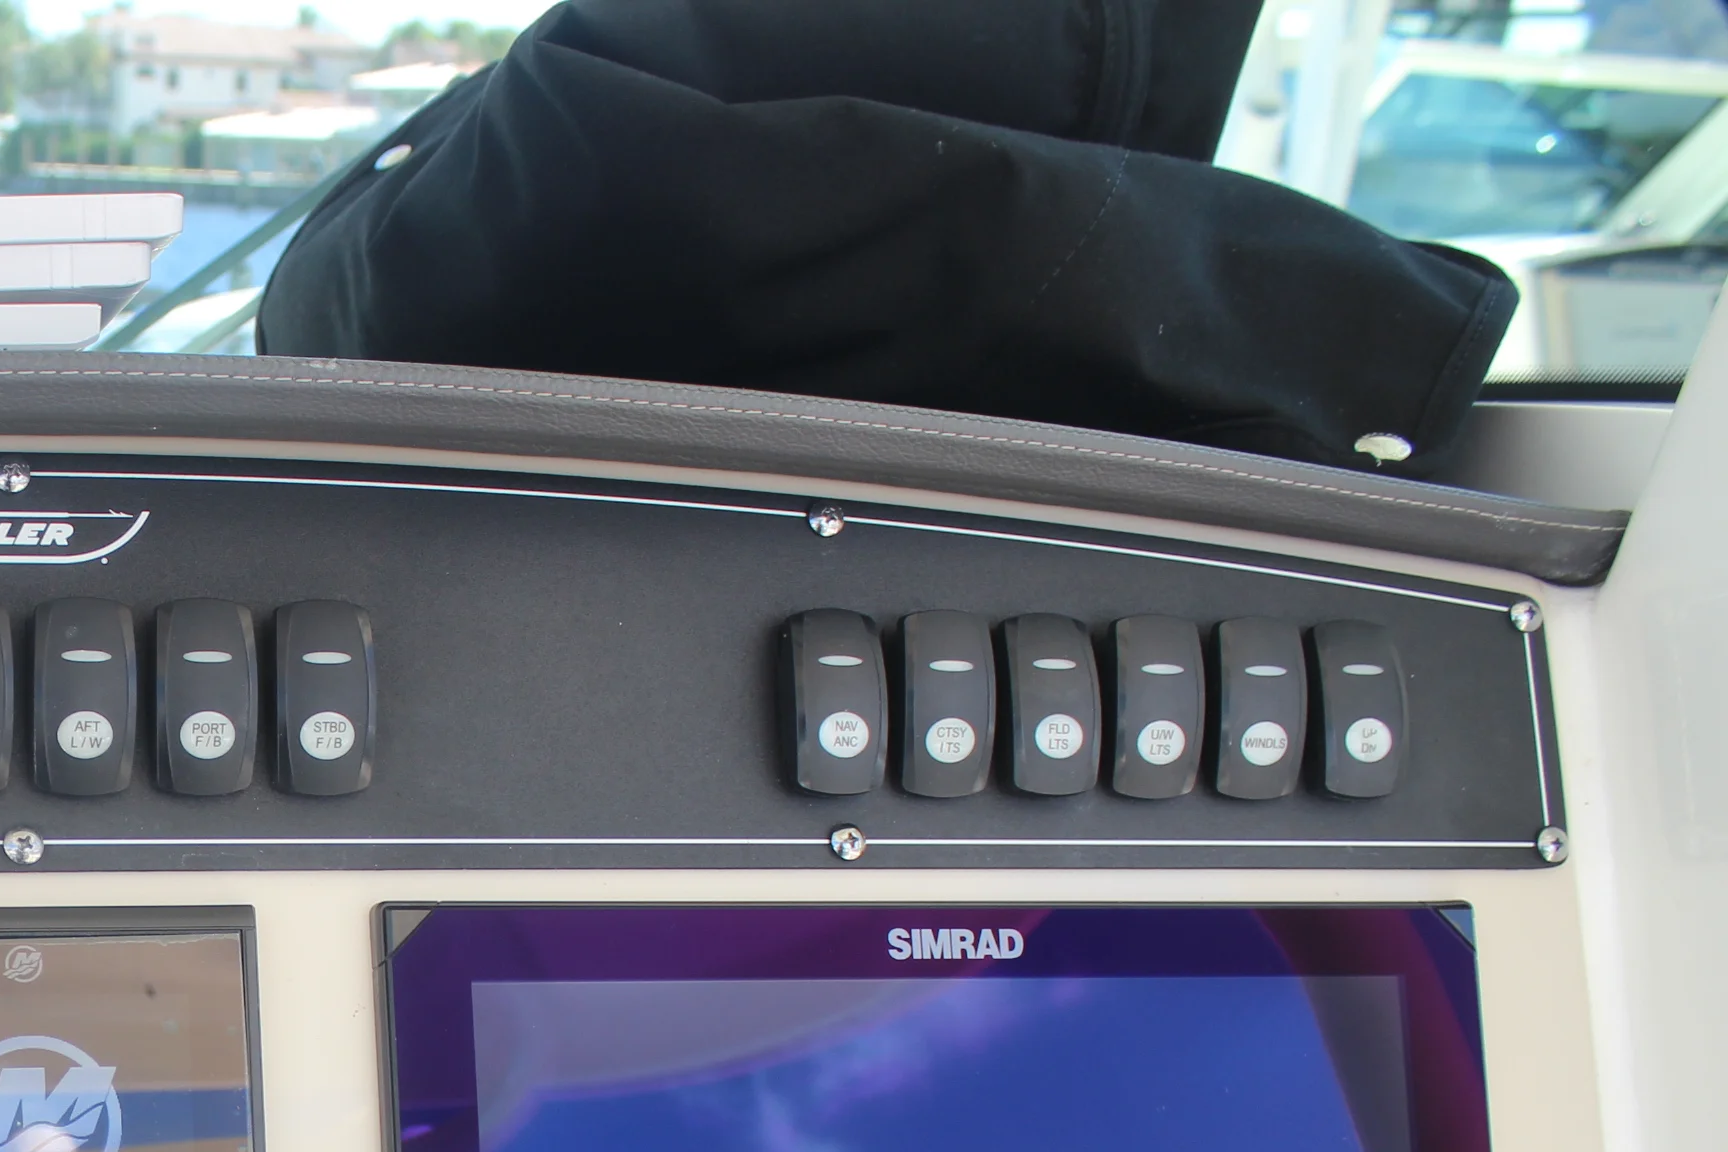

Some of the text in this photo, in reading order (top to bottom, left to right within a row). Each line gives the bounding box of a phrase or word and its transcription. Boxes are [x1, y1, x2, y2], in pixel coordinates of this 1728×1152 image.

[74, 720, 101, 733] AFT
[192, 722, 227, 735] PORT
[313, 721, 348, 734] STBD
[835, 720, 859, 732] NAV
[936, 726, 968, 738] CTSY
[1048, 723, 1071, 735] FLD
[1150, 729, 1175, 741] U/W
[833, 736, 859, 748] ANC
[1048, 738, 1069, 750] LTS
[1244, 737, 1287, 749] WINDLS
[1149, 744, 1171, 756] LTS
[887, 927, 1025, 961] SIMRAD
